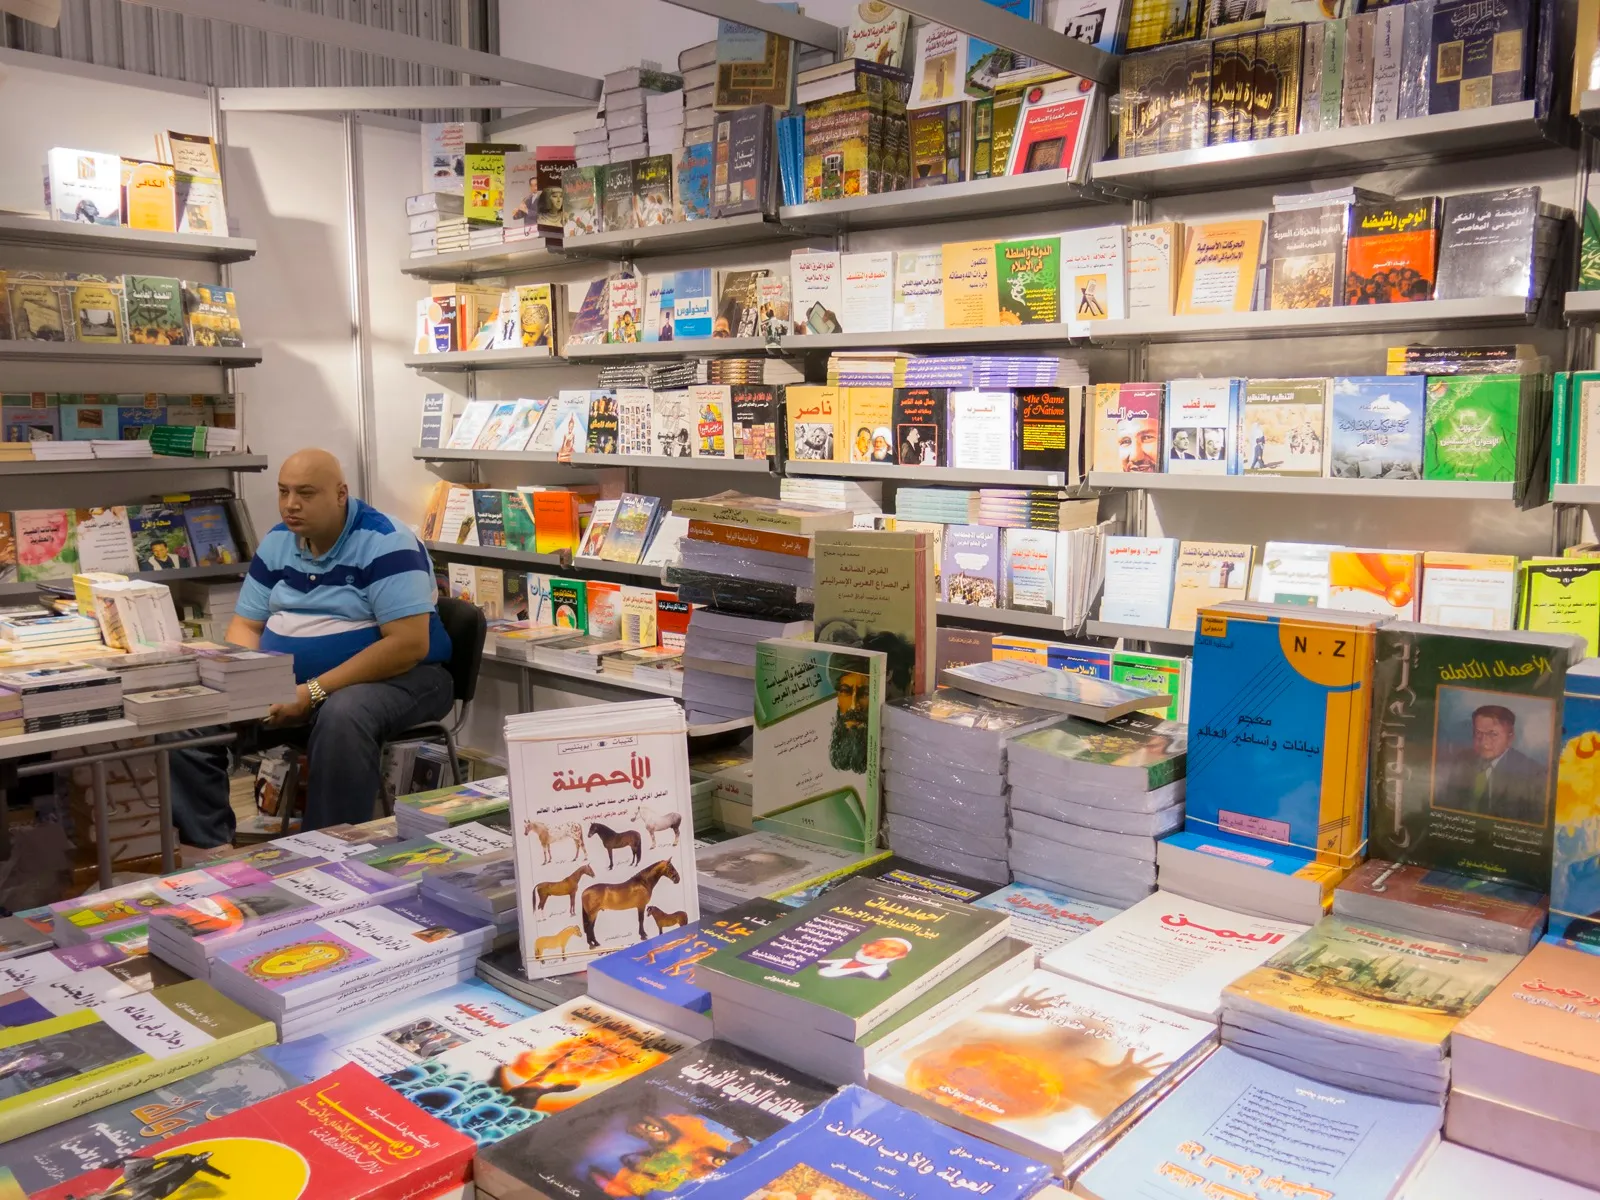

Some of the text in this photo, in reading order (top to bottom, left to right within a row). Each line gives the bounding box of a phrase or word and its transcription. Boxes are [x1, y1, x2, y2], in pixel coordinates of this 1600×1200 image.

[793, 400, 832, 419] ناصر
[1023, 407, 1031, 418] of
[1203, 402, 1216, 411] سيد
[1294, 637, 1346, 657] N Z
[1237, 713, 1272, 727] معجم
[1197, 725, 1229, 740] العالم
[1282, 738, 1320, 755] ديانات
[552, 751, 651, 793] الأحصنة
[1160, 912, 1285, 945] اليمن
[825, 1121, 883, 1147] المقارن
[877, 1143, 935, 1175] والأدب
[936, 1166, 996, 1195] العولمة
